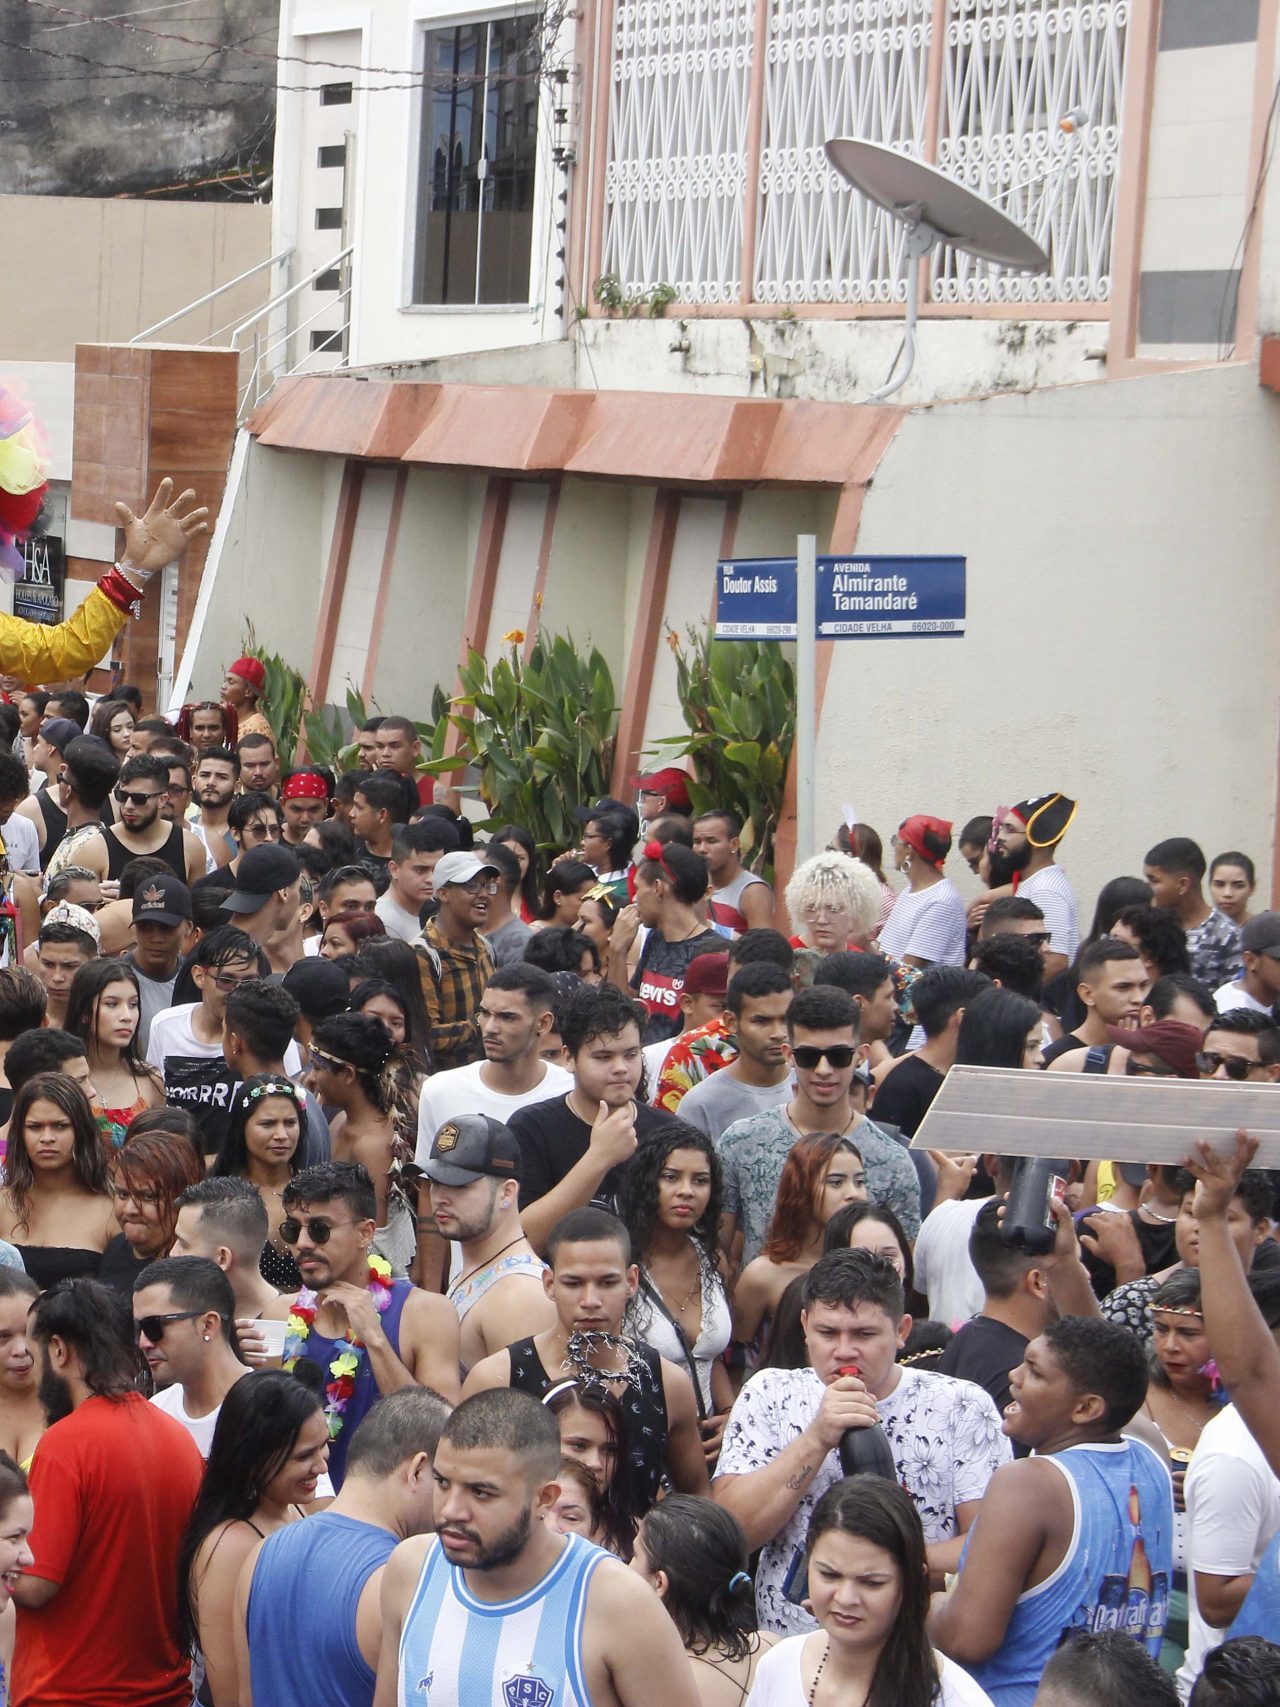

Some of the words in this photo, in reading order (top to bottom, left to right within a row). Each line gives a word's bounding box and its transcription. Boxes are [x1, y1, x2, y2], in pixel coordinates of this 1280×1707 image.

[833, 563, 870, 573] AVENIDA
[723, 577, 752, 594] Doutor
[753, 575, 778, 593] Assis
[832, 574, 907, 592] Almirante
[832, 592, 918, 611] Tamandaré
[722, 624, 739, 633] CIDADE
[740, 624, 755, 633] VELHA
[834, 623, 864, 633] CIDADE
[867, 622, 892, 632] VELHA
[912, 621, 955, 631] 66020-000
[141, 901, 165, 909] adidas
